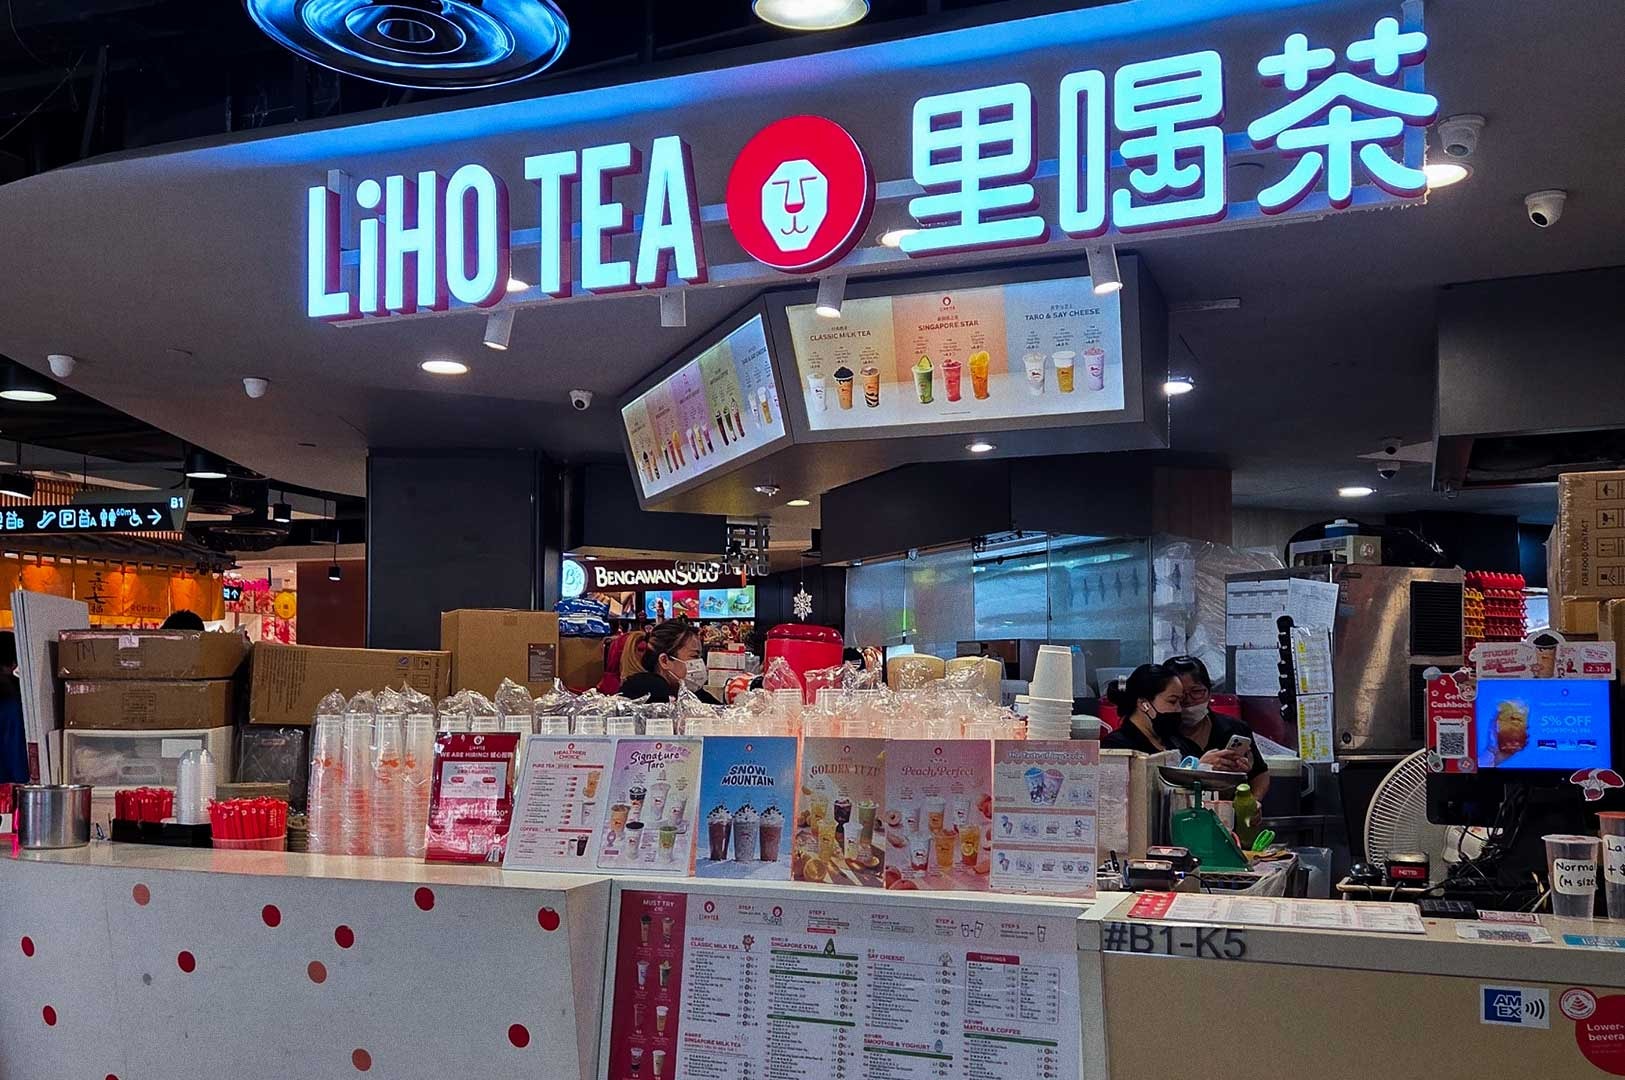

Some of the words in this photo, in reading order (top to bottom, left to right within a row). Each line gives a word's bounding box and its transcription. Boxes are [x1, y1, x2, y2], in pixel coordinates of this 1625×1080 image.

[307, 163, 502, 319] LiHO
[524, 134, 702, 296] TEA
[1025, 313, 1045, 321] TARO
[1053, 311, 1068, 320] SAY
[1069, 307, 1101, 317] CHEESE
[918, 321, 959, 332] SINGAPORE
[960, 319, 979, 329] STAR
[809, 332, 838, 342] CLASSIC
[857, 330, 872, 338] TEA
[169, 496, 184, 509] B1
[1581, 519, 1590, 552] CONTACT
[1581, 552, 1590, 572] FOOD
[594, 566, 677, 588] BENGAWAN
[1581, 572, 1590, 587] FOR
[1431, 700, 1473, 708] Cashback
[1541, 715, 1562, 726] 5%
[1564, 715, 1592, 726] OFF
[629, 750, 680, 766] Signature
[728, 764, 767, 776] SNOW
[902, 766, 937, 778] Peach
[935, 766, 975, 778] Perfect
[720, 774, 776, 787] MOUNTAIN
[1104, 919, 1247, 960] #B1-K5
[1586, 1023, 1625, 1032] Lower-
